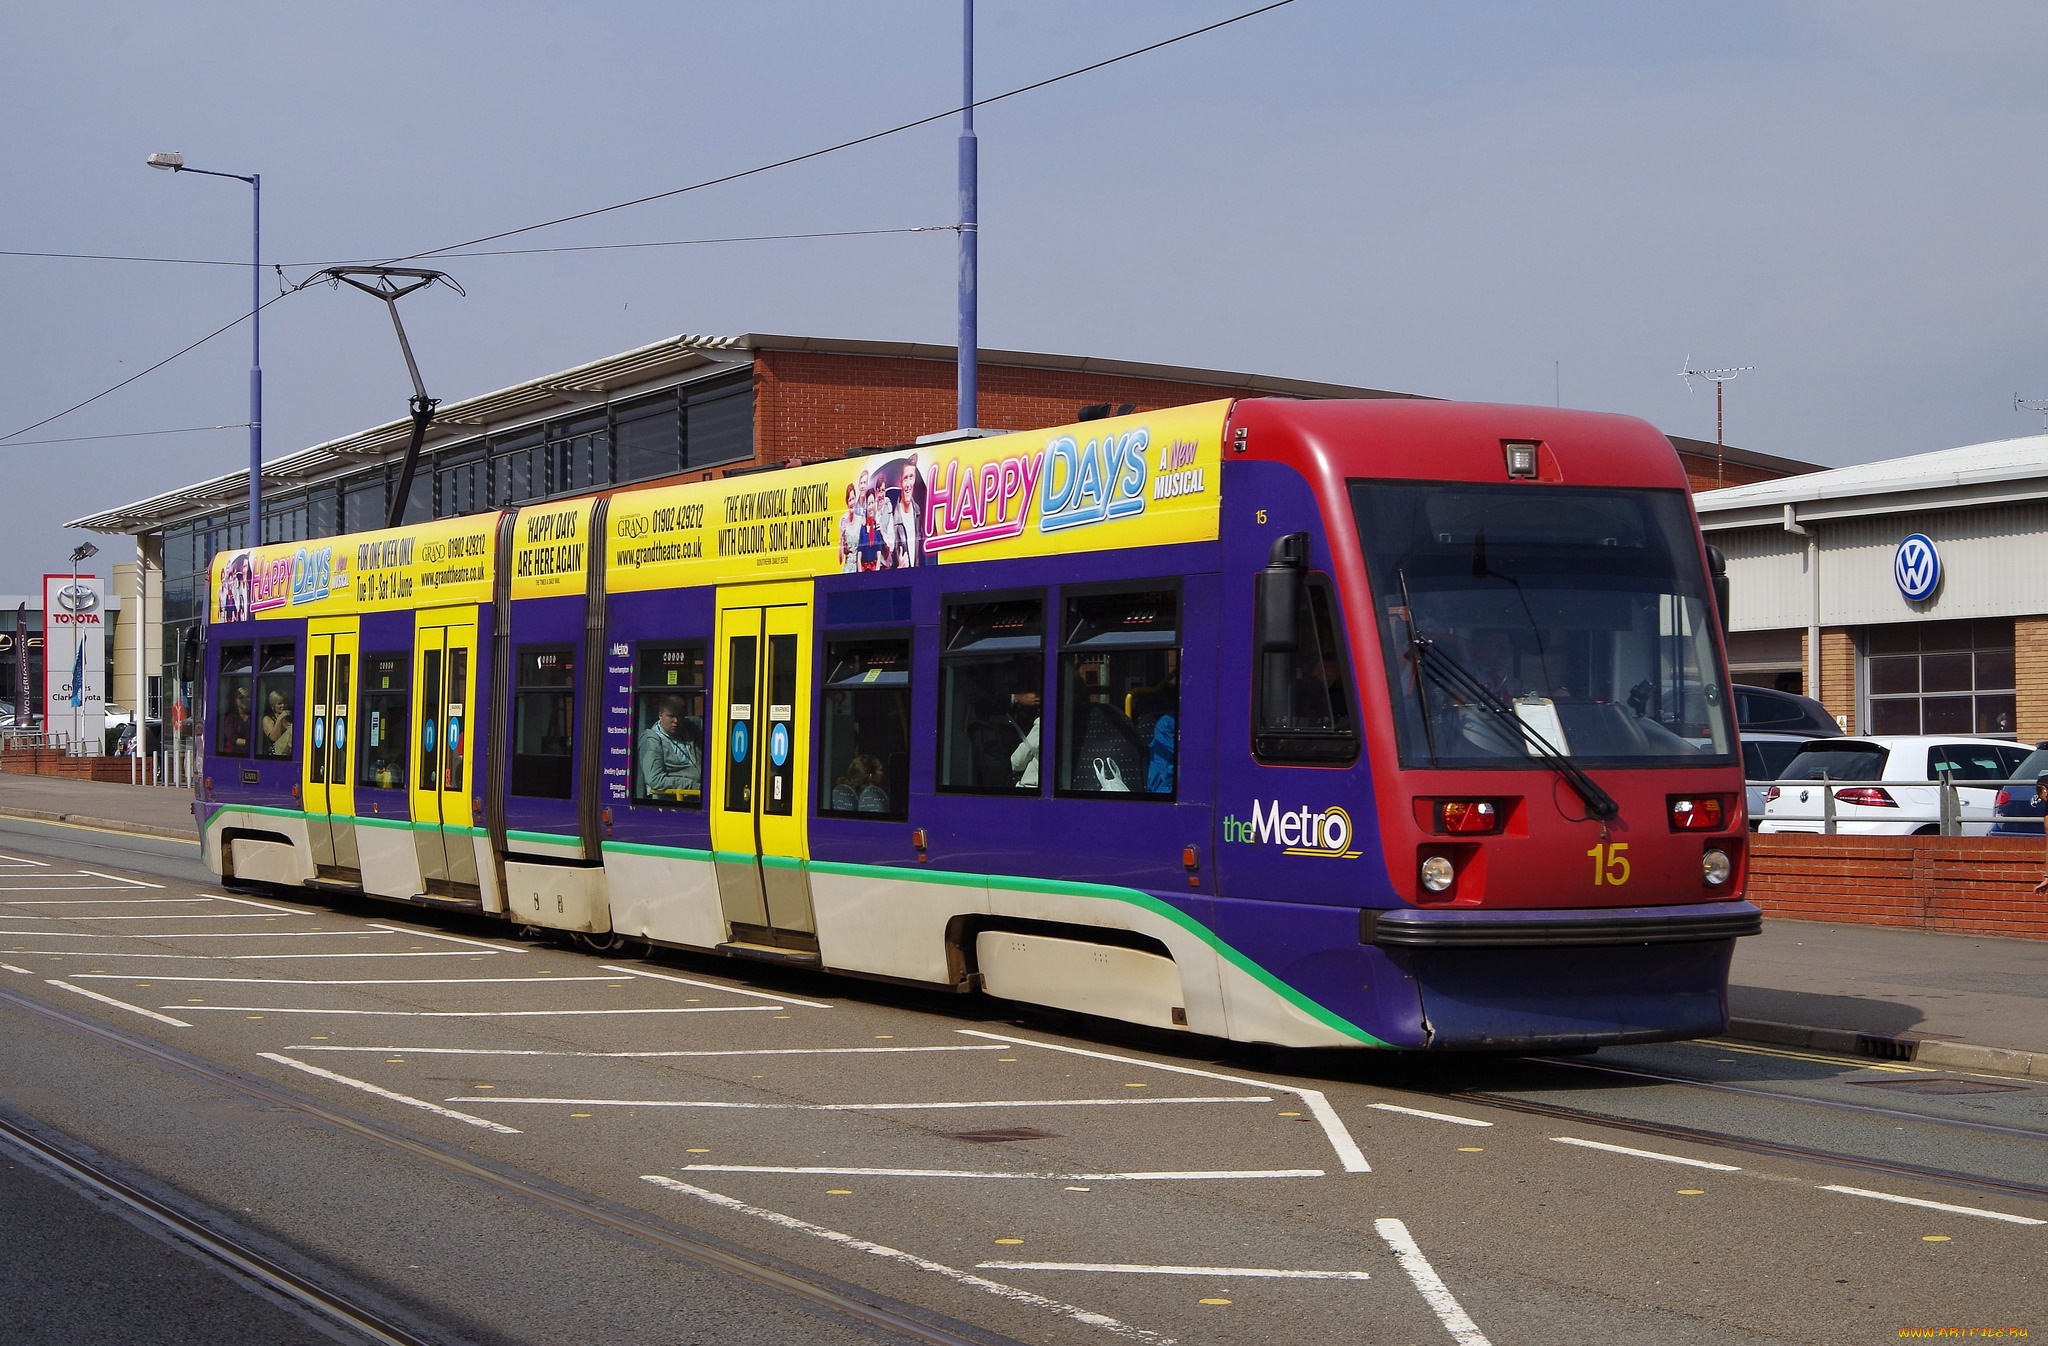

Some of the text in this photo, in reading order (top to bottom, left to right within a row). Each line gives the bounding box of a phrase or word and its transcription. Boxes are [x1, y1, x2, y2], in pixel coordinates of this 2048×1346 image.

[1159, 438, 1198, 472] A New
[924, 429, 1149, 540] HAPPY DAYS
[1153, 468, 1205, 500] MUSICAL
[740, 493, 756, 521] NEW
[756, 489, 789, 519] MUSICAL,
[792, 482, 828, 515] BURSTING
[1256, 511, 1267, 524] 15
[556, 510, 577, 539] DAYS
[617, 504, 703, 538] GRAND 01902 429212
[357, 536, 416, 571] FOR ONE WEEK ONLY
[422, 534, 485, 562] GRAND 01902 429212
[617, 536, 702, 569] www.grandtheatre.co.uk
[718, 528, 736, 557] WITH
[738, 525, 767, 556] COLOUR,
[770, 522, 787, 552] SONG
[790, 520, 804, 550] AND
[250, 546, 332, 605] HAPPY DAYS
[421, 561, 484, 589] www.grandtheatre.co.uk
[518, 549, 532, 577] ARE
[534, 547, 554, 576] HERE
[357, 576, 366, 601] Tue
[368, 574, 374, 601] 10
[379, 573, 388, 600] Sat
[390, 572, 396, 599] 14
[397, 571, 412, 598] June
[1587, 843, 1630, 886] 15
